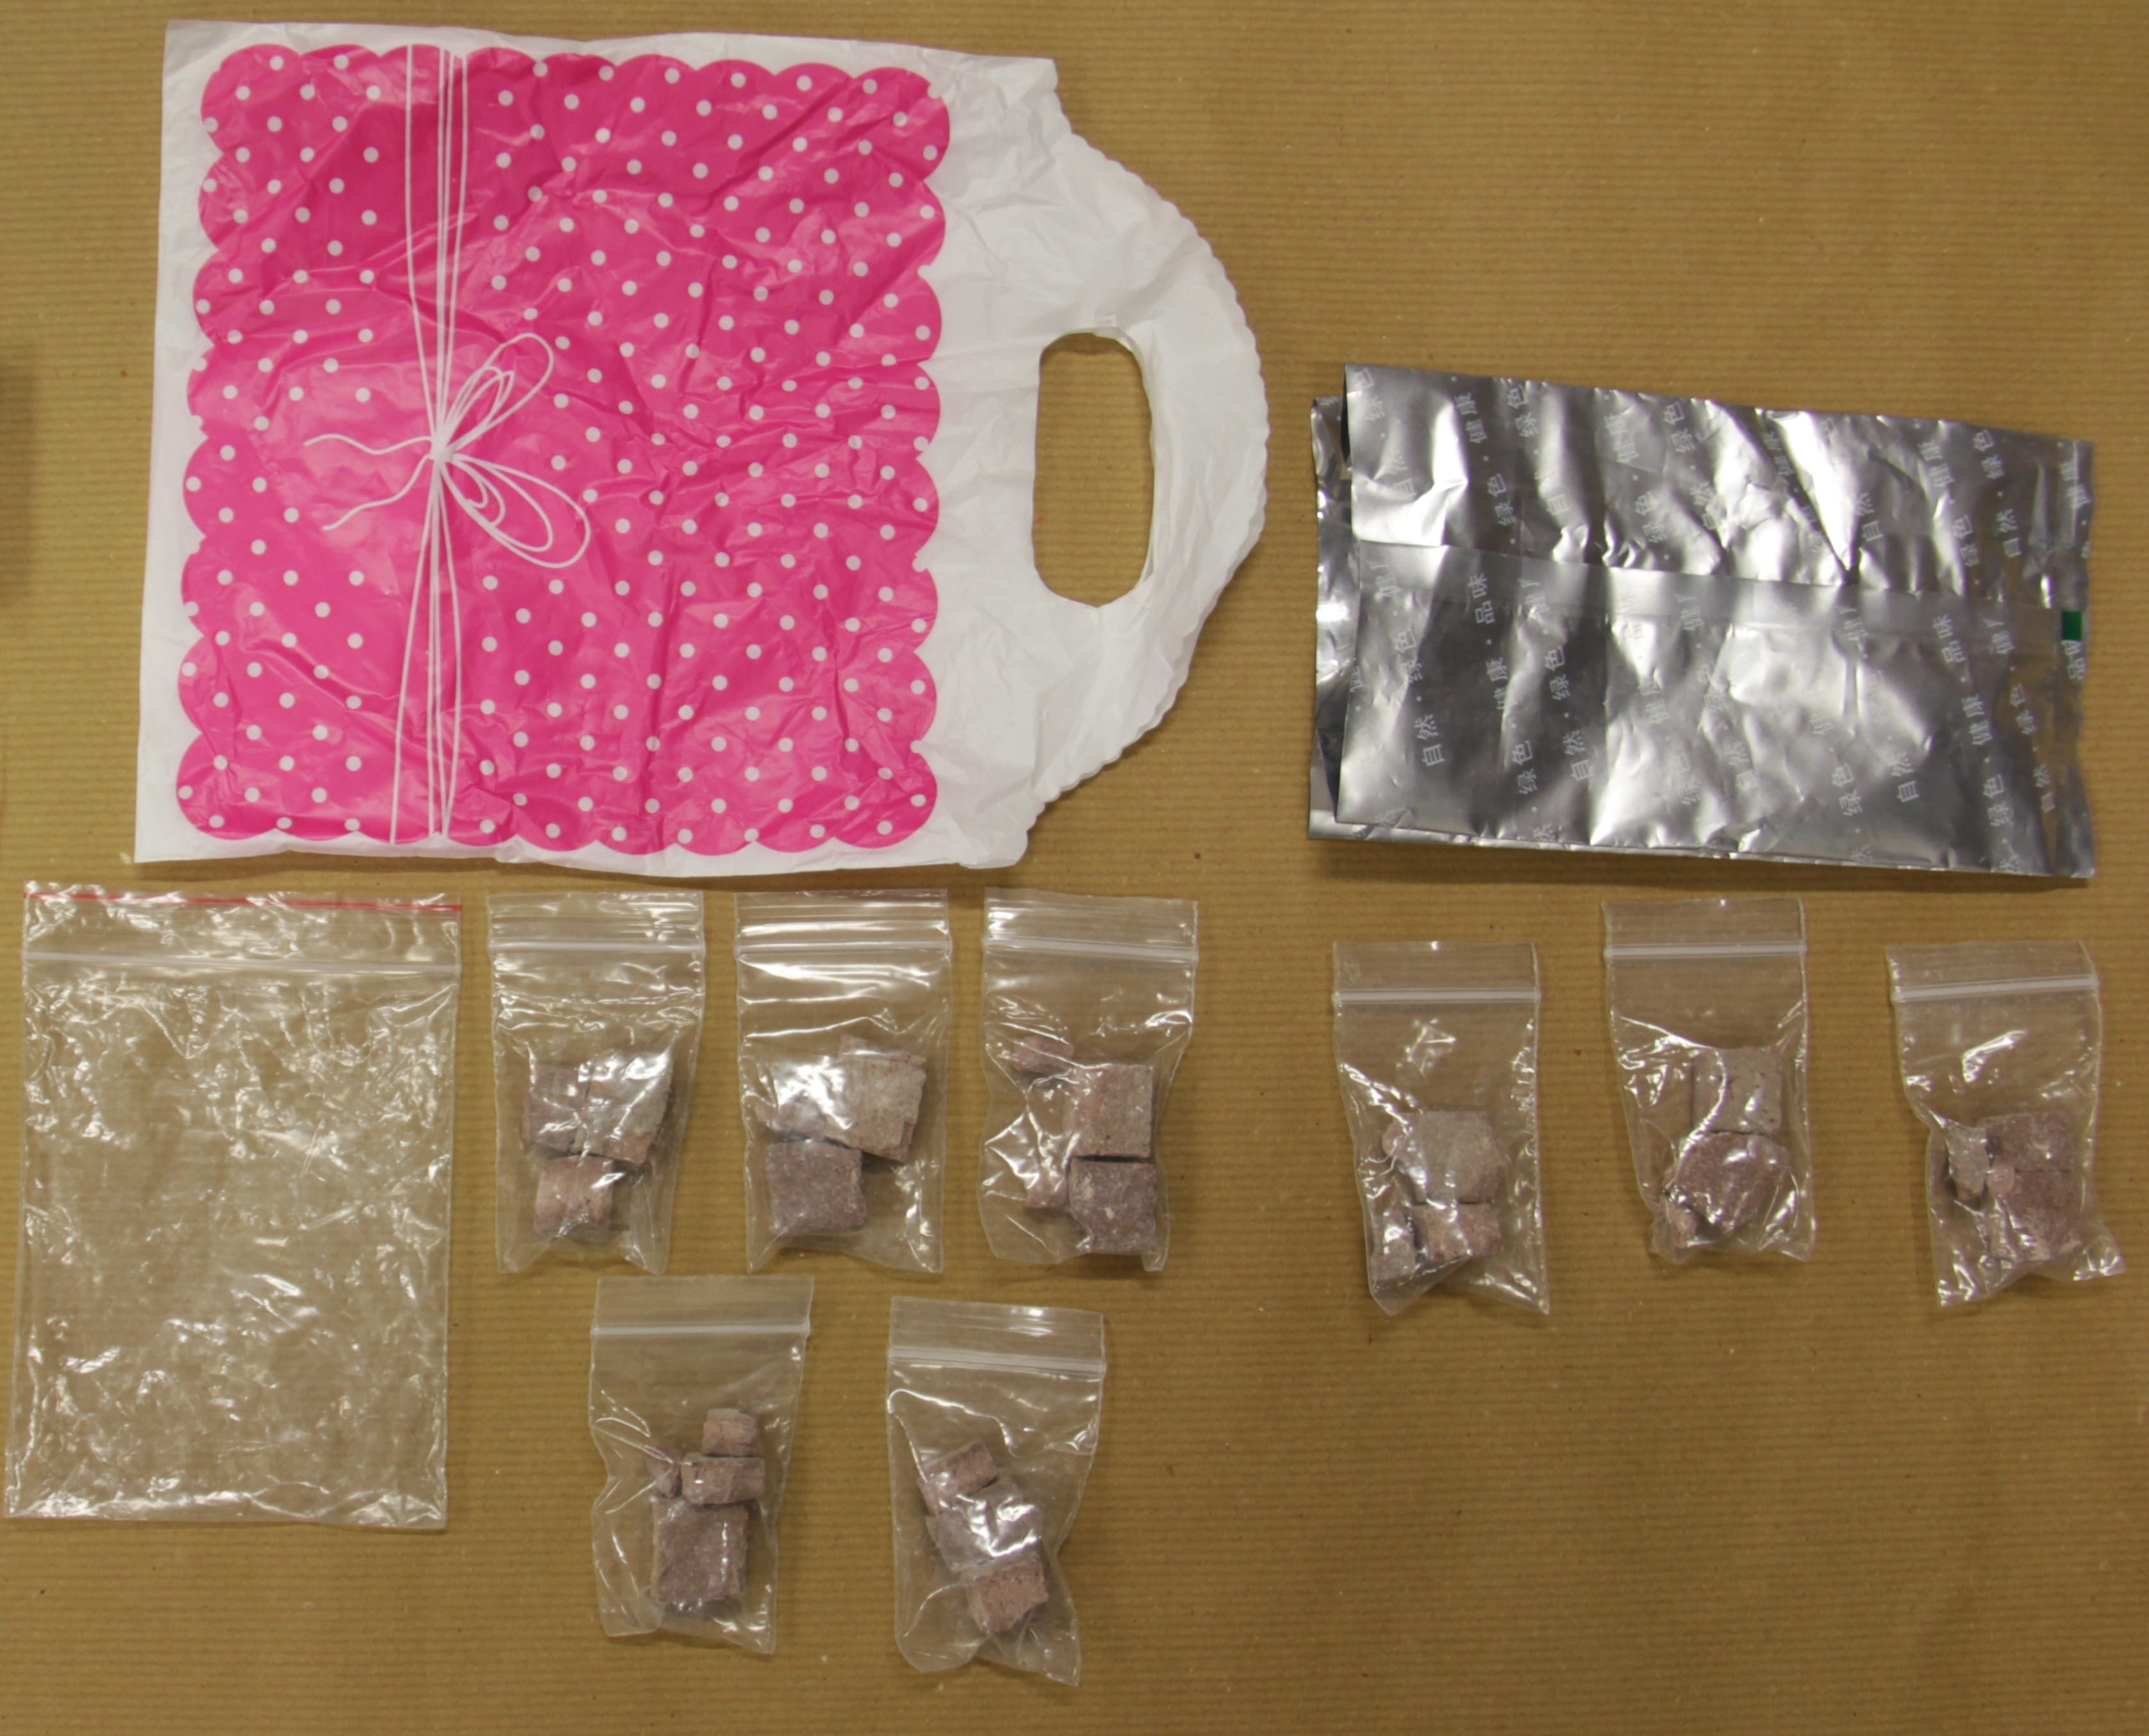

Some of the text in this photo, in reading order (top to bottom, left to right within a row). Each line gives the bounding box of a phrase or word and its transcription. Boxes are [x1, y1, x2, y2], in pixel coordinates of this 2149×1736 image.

[1353, 368, 1386, 420] 绿色
[1507, 386, 1538, 438] 绿色
[1663, 401, 1694, 453] 绿色
[1456, 392, 1516, 526] 绿色 健康
[1604, 413, 1667, 542] 绿色 健康
[1855, 492, 1884, 541] 自然
[1918, 439, 1979, 566] 绿色 健康
[1973, 429, 2021, 558] 自然 绿色
[1468, 573, 1495, 624] 品味
[1393, 627, 1423, 683] 绿色
[1932, 615, 1966, 663] 品味
[1544, 646, 1571, 700] 绿色
[1962, 693, 1993, 745] 健康
[2009, 684, 2036, 734] 绿色
[1414, 714, 1445, 767] 自然
[1562, 729, 1594, 781] 自然
[1726, 741, 1759, 791] 自然
[1512, 740, 1538, 795] 绿色
[1830, 763, 1864, 816] 绿色
[1888, 750, 1920, 802] 自然
[1982, 774, 2014, 826] 绿色
